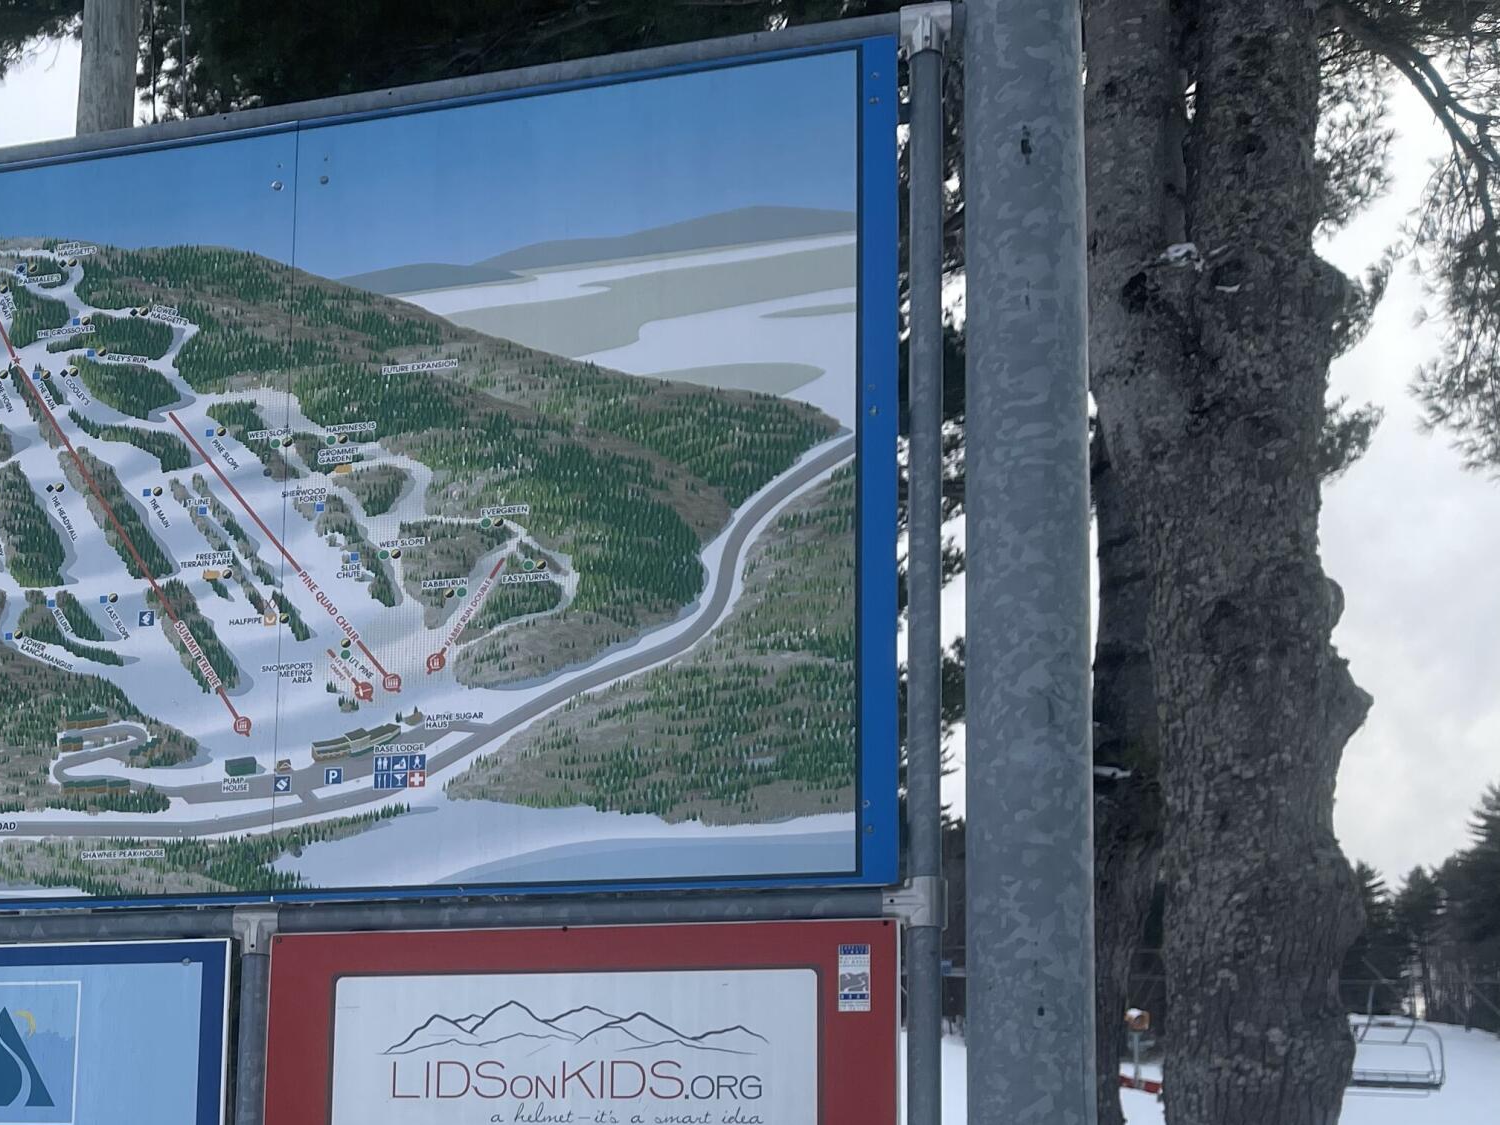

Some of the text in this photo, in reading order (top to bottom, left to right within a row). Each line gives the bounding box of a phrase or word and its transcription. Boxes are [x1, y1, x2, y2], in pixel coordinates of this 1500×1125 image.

[383, 362, 410, 374] FUTURE
[326, 424, 366, 433] HAPPINESS
[318, 448, 359, 457] GROMMET
[319, 455, 352, 464] GARDEN
[282, 488, 326, 498] SHERWOOD
[481, 506, 528, 516] EVERGREEN
[380, 537, 425, 548] WEST SLOPE
[196, 552, 231, 561] FREESTYLE
[181, 558, 231, 569] TERRAIN PARK
[341, 564, 360, 572] SLIDE
[336, 571, 361, 579] CHUTE
[502, 573, 550, 583] EASY TURNS
[422, 578, 468, 589] RABBIT RUN
[300, 570, 359, 643] PINE QUAD CHAIR
[229, 617, 262, 626] HALFPIPE
[174, 621, 221, 689] SUMMIT TRIPLE
[262, 663, 313, 673] SNOWSPORTS
[279, 670, 313, 678] MEETING
[292, 676, 312, 684] AREA
[426, 712, 484, 722] ALPINE SUGAR
[425, 721, 448, 729] HAUS
[396, 743, 424, 752] LODGE
[223, 778, 244, 786] PUMP
[223, 784, 249, 792] HOUSE
[83, 850, 116, 859] SHAWNEE
[490, 1114, 505, 1124] a
[630, 1113, 644, 1124] a
[654, 1106, 712, 1125] smart
[720, 1106, 764, 1125] idea
